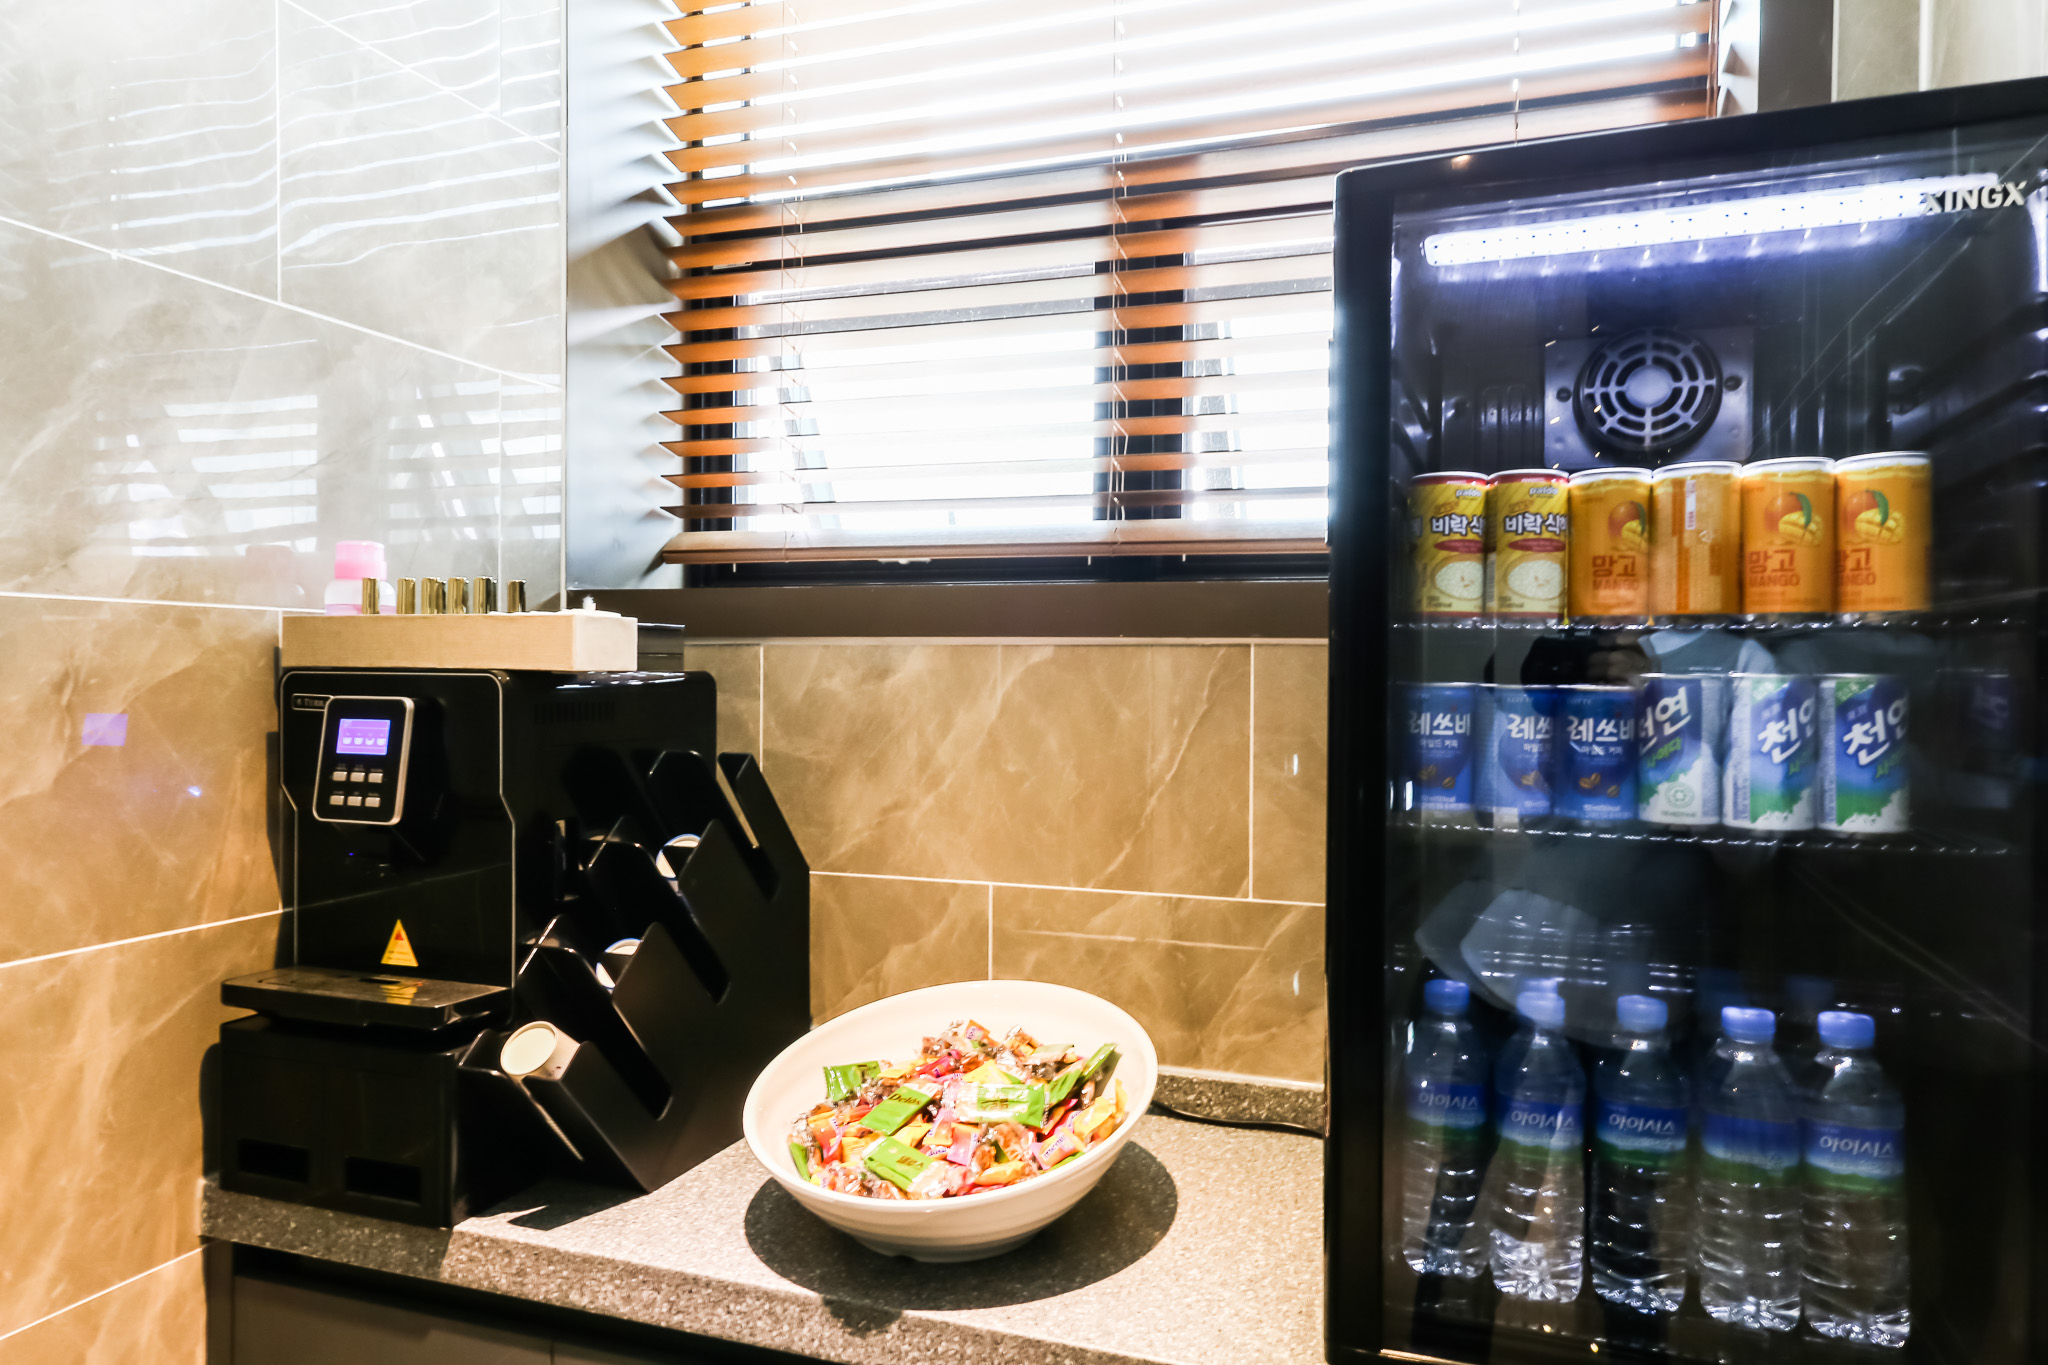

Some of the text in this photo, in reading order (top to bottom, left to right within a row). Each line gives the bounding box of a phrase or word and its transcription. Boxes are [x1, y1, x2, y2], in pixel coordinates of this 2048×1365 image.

[1455, 487, 1482, 499] paldo
[1529, 485, 1559, 498] paldo
[1592, 555, 1637, 578] 망고
[1748, 549, 1796, 575] 망고
[1592, 579, 1639, 591] MANGO
[1748, 573, 1801, 588] MANGO
[1408, 711, 1471, 737] 레쓰비
[1567, 715, 1635, 743] 레쓰비
[1418, 1091, 1480, 1111] 아이시스
[1510, 1109, 1576, 1131] 아이시스
[1607, 1112, 1676, 1136] 아이시스
[1818, 1134, 1897, 1159] 아이시스
